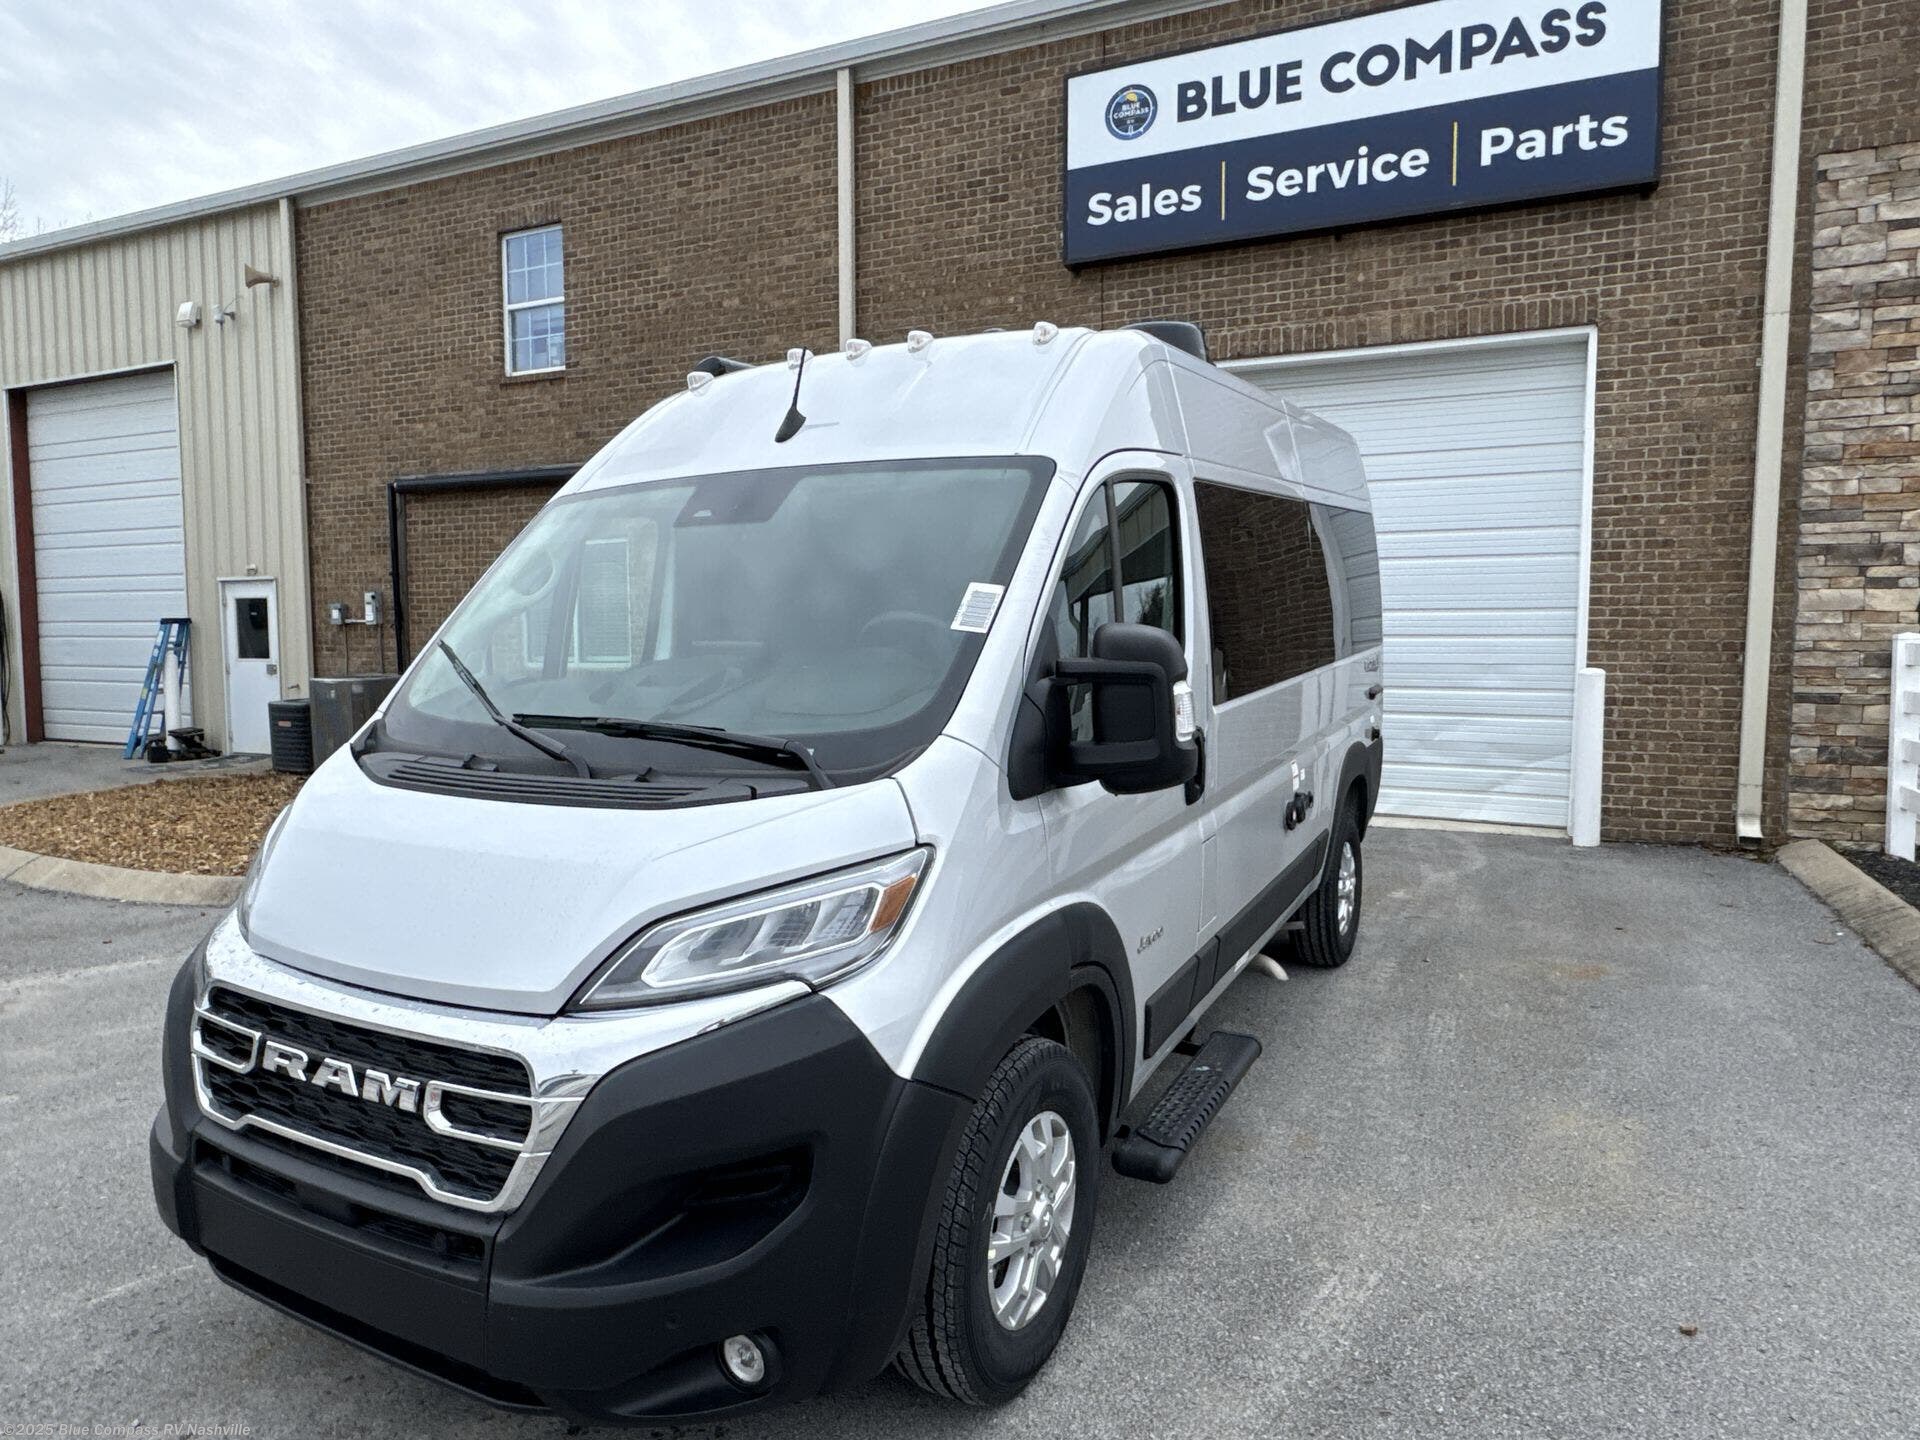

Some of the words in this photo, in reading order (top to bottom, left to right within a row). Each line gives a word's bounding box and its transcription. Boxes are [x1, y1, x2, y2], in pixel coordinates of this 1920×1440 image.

[1176, 59, 1303, 123] BLUE
[1320, 1, 1608, 95] COMPASS
[1113, 106, 1150, 119] COMPASS
[1086, 183, 1203, 226] Sales
[1245, 144, 1430, 202] Service
[1480, 113, 1629, 167] Parts
[262, 1040, 421, 1113] RAM
